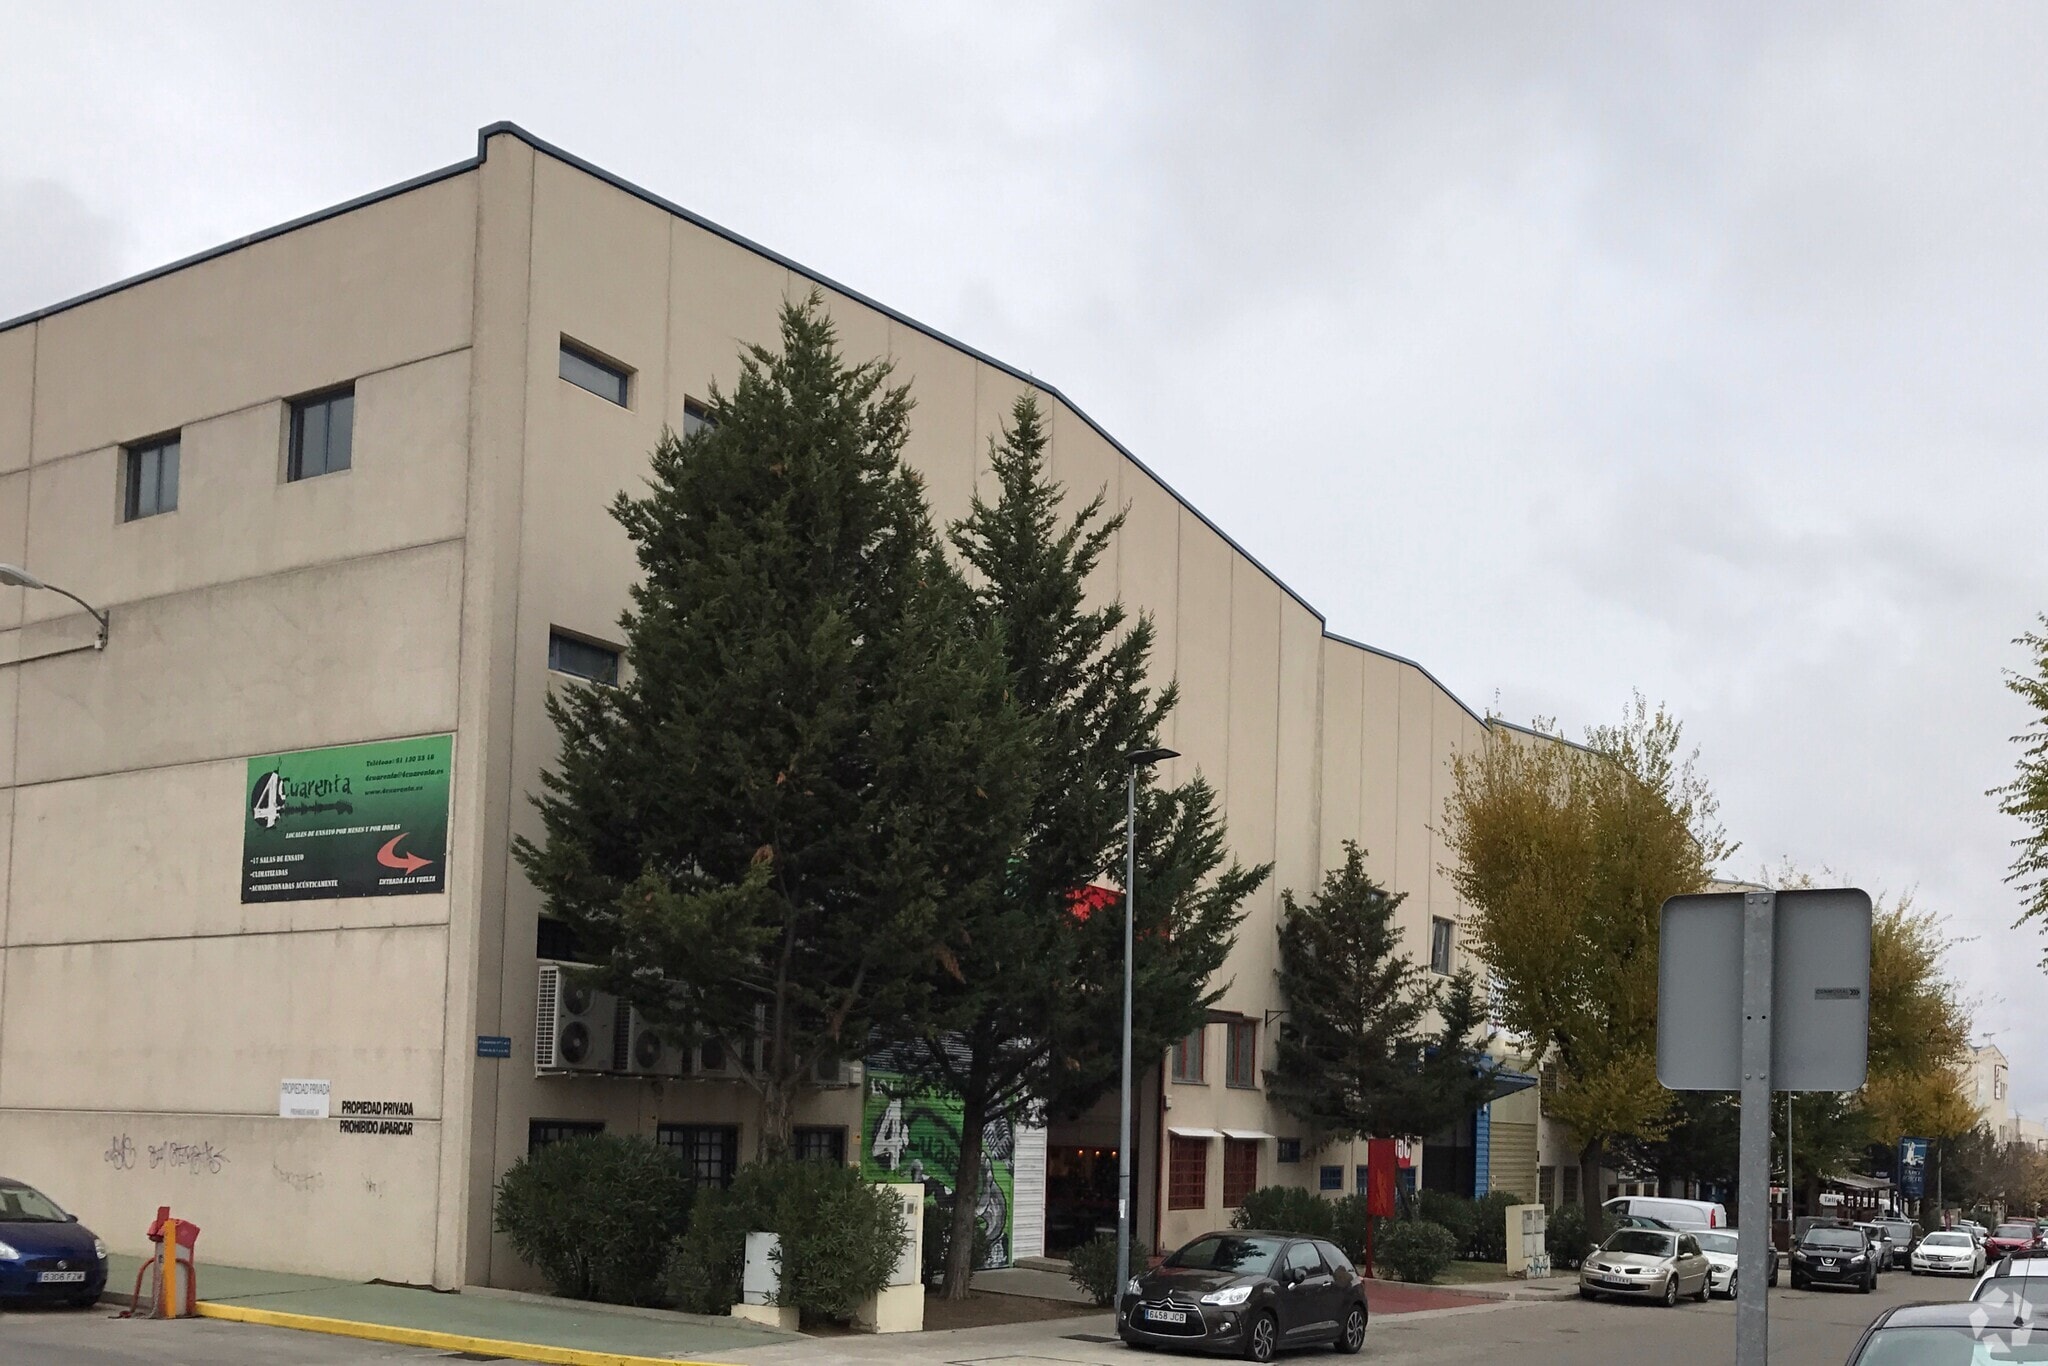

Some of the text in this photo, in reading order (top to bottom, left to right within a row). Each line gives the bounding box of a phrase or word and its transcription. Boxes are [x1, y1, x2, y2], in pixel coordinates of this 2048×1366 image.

[259, 855, 276, 864] SALAS
[282, 1083, 330, 1096] PROPIEDAD PRIVADA
[341, 1100, 414, 1116] PROPIEDAD PRIVADA
[339, 1120, 414, 1136] PROHIBIDO APARCAR
[1150, 1310, 1185, 1322] 6458 JCB
